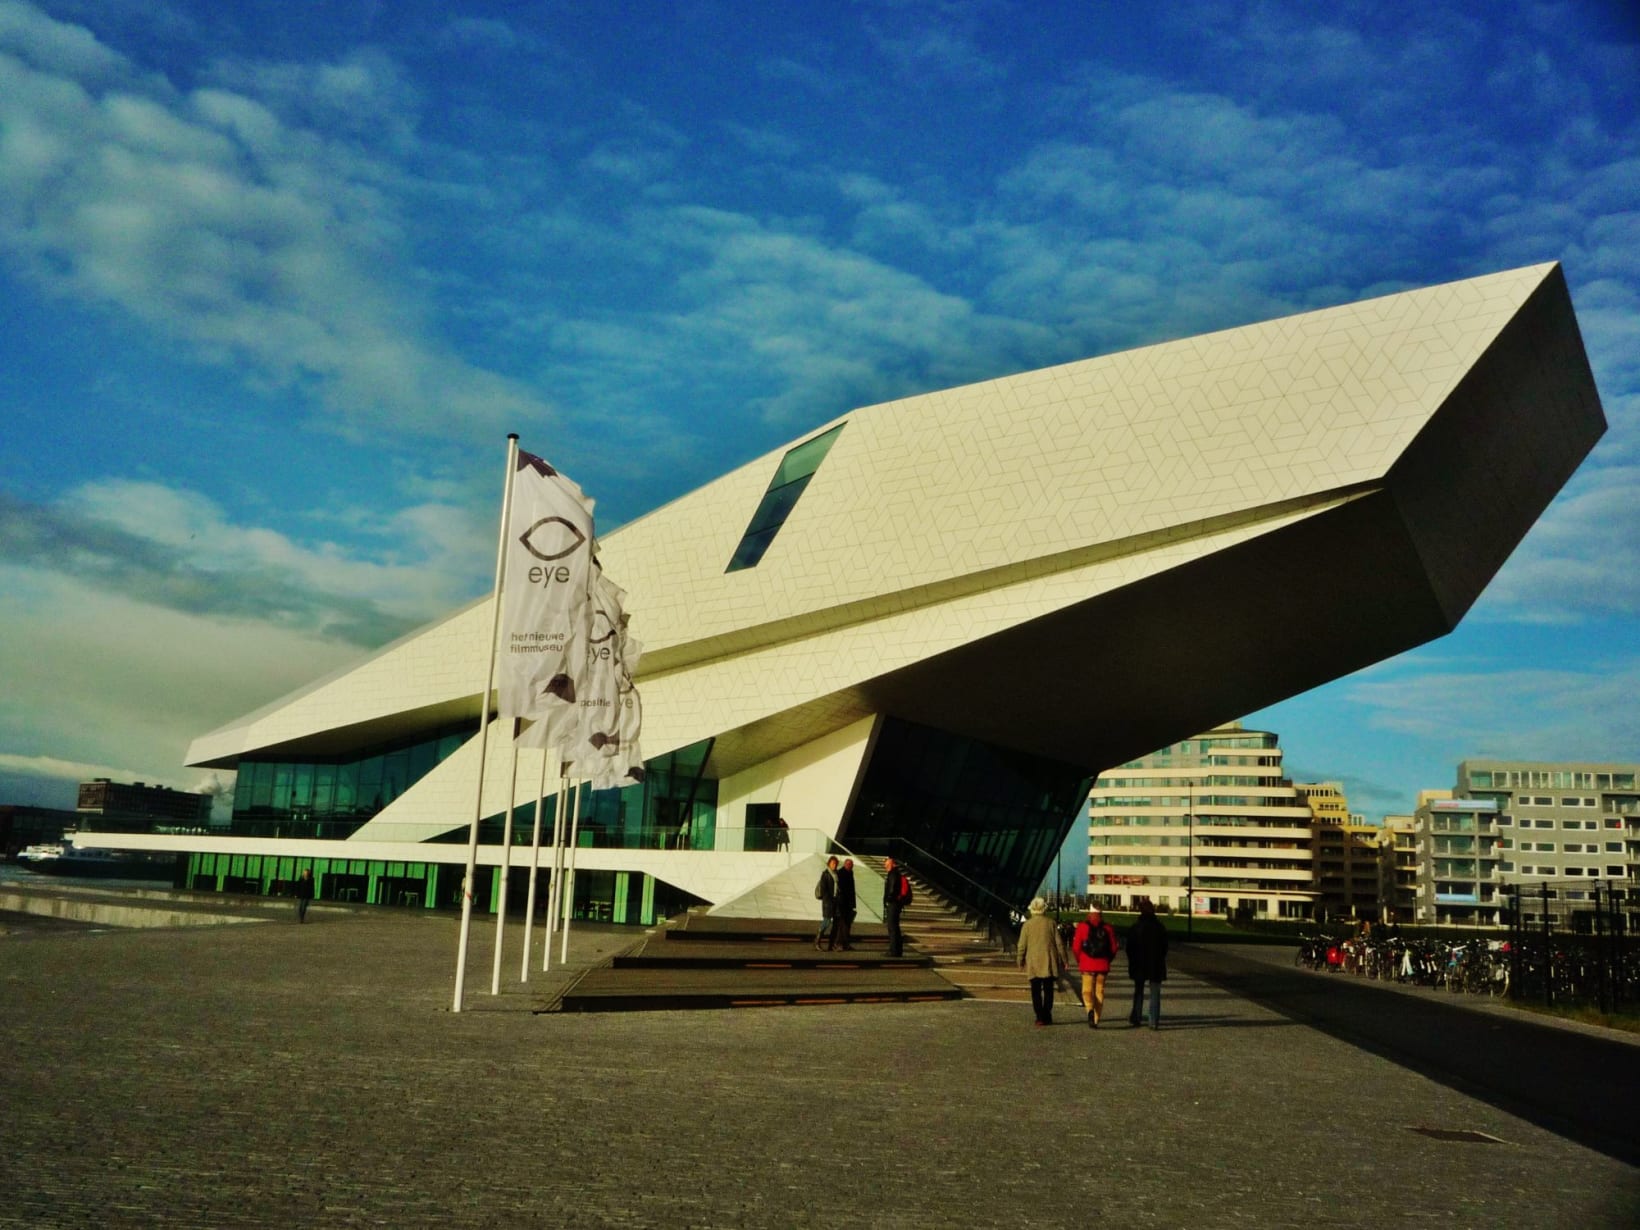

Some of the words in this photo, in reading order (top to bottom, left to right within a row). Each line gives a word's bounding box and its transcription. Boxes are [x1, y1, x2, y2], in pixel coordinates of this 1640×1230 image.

[528, 566, 570, 589] eye
[510, 643, 564, 654] filmmuseu
[590, 647, 611, 665] ye
